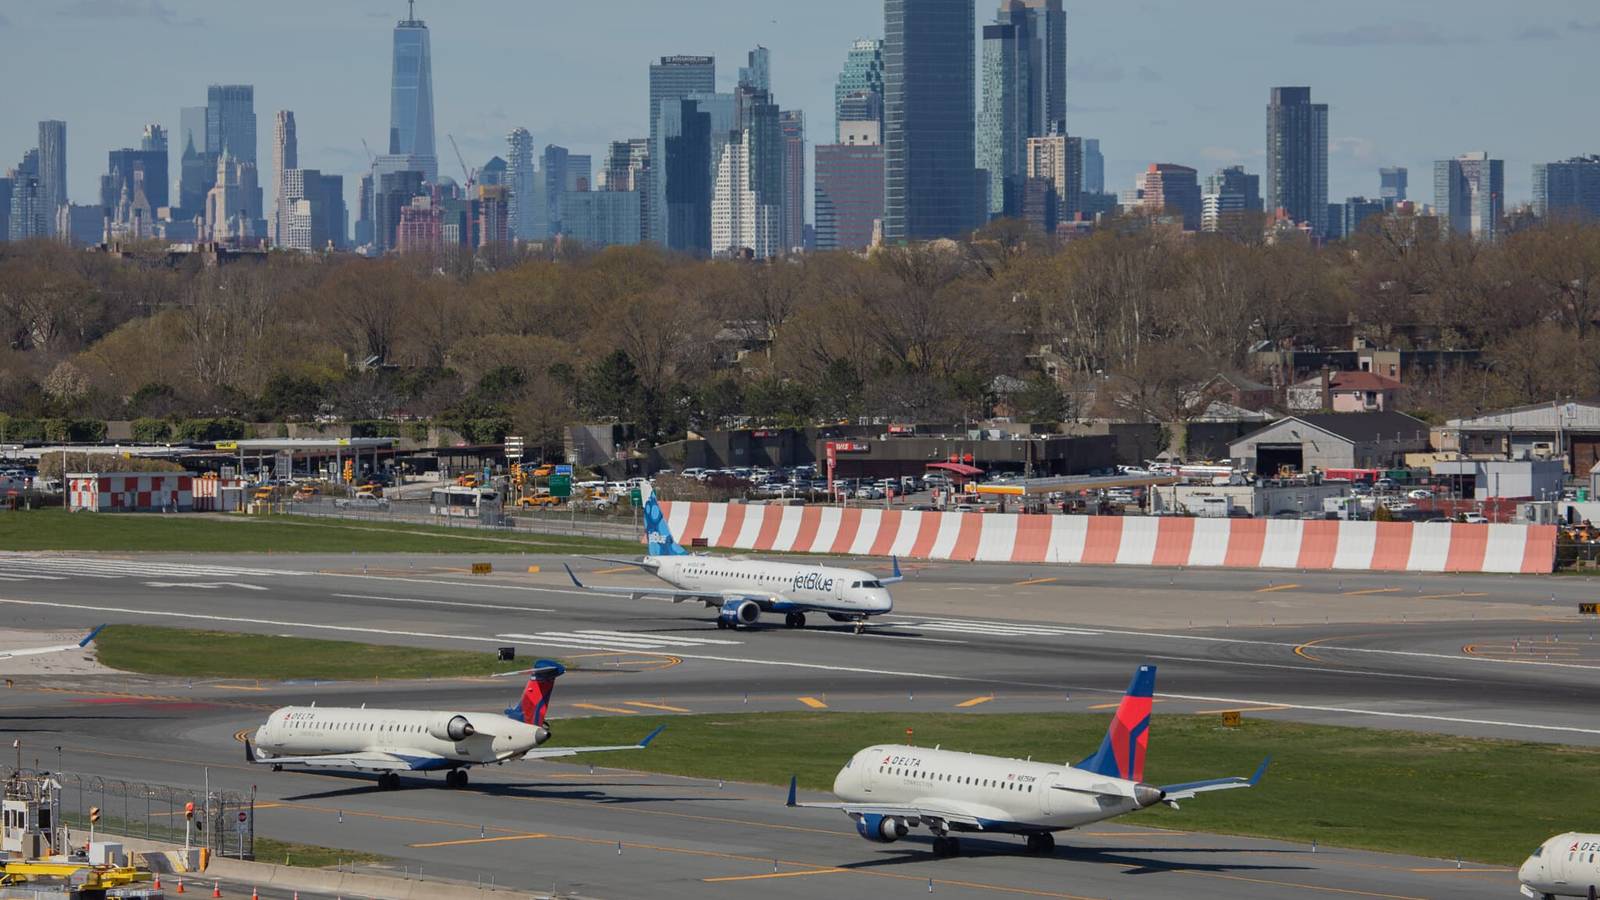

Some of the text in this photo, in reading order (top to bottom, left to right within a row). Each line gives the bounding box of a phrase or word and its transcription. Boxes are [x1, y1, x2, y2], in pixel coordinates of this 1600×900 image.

[792, 571, 833, 593] jetBlue
[291, 712, 315, 720] DELTA
[891, 755, 922, 768] DELTA
